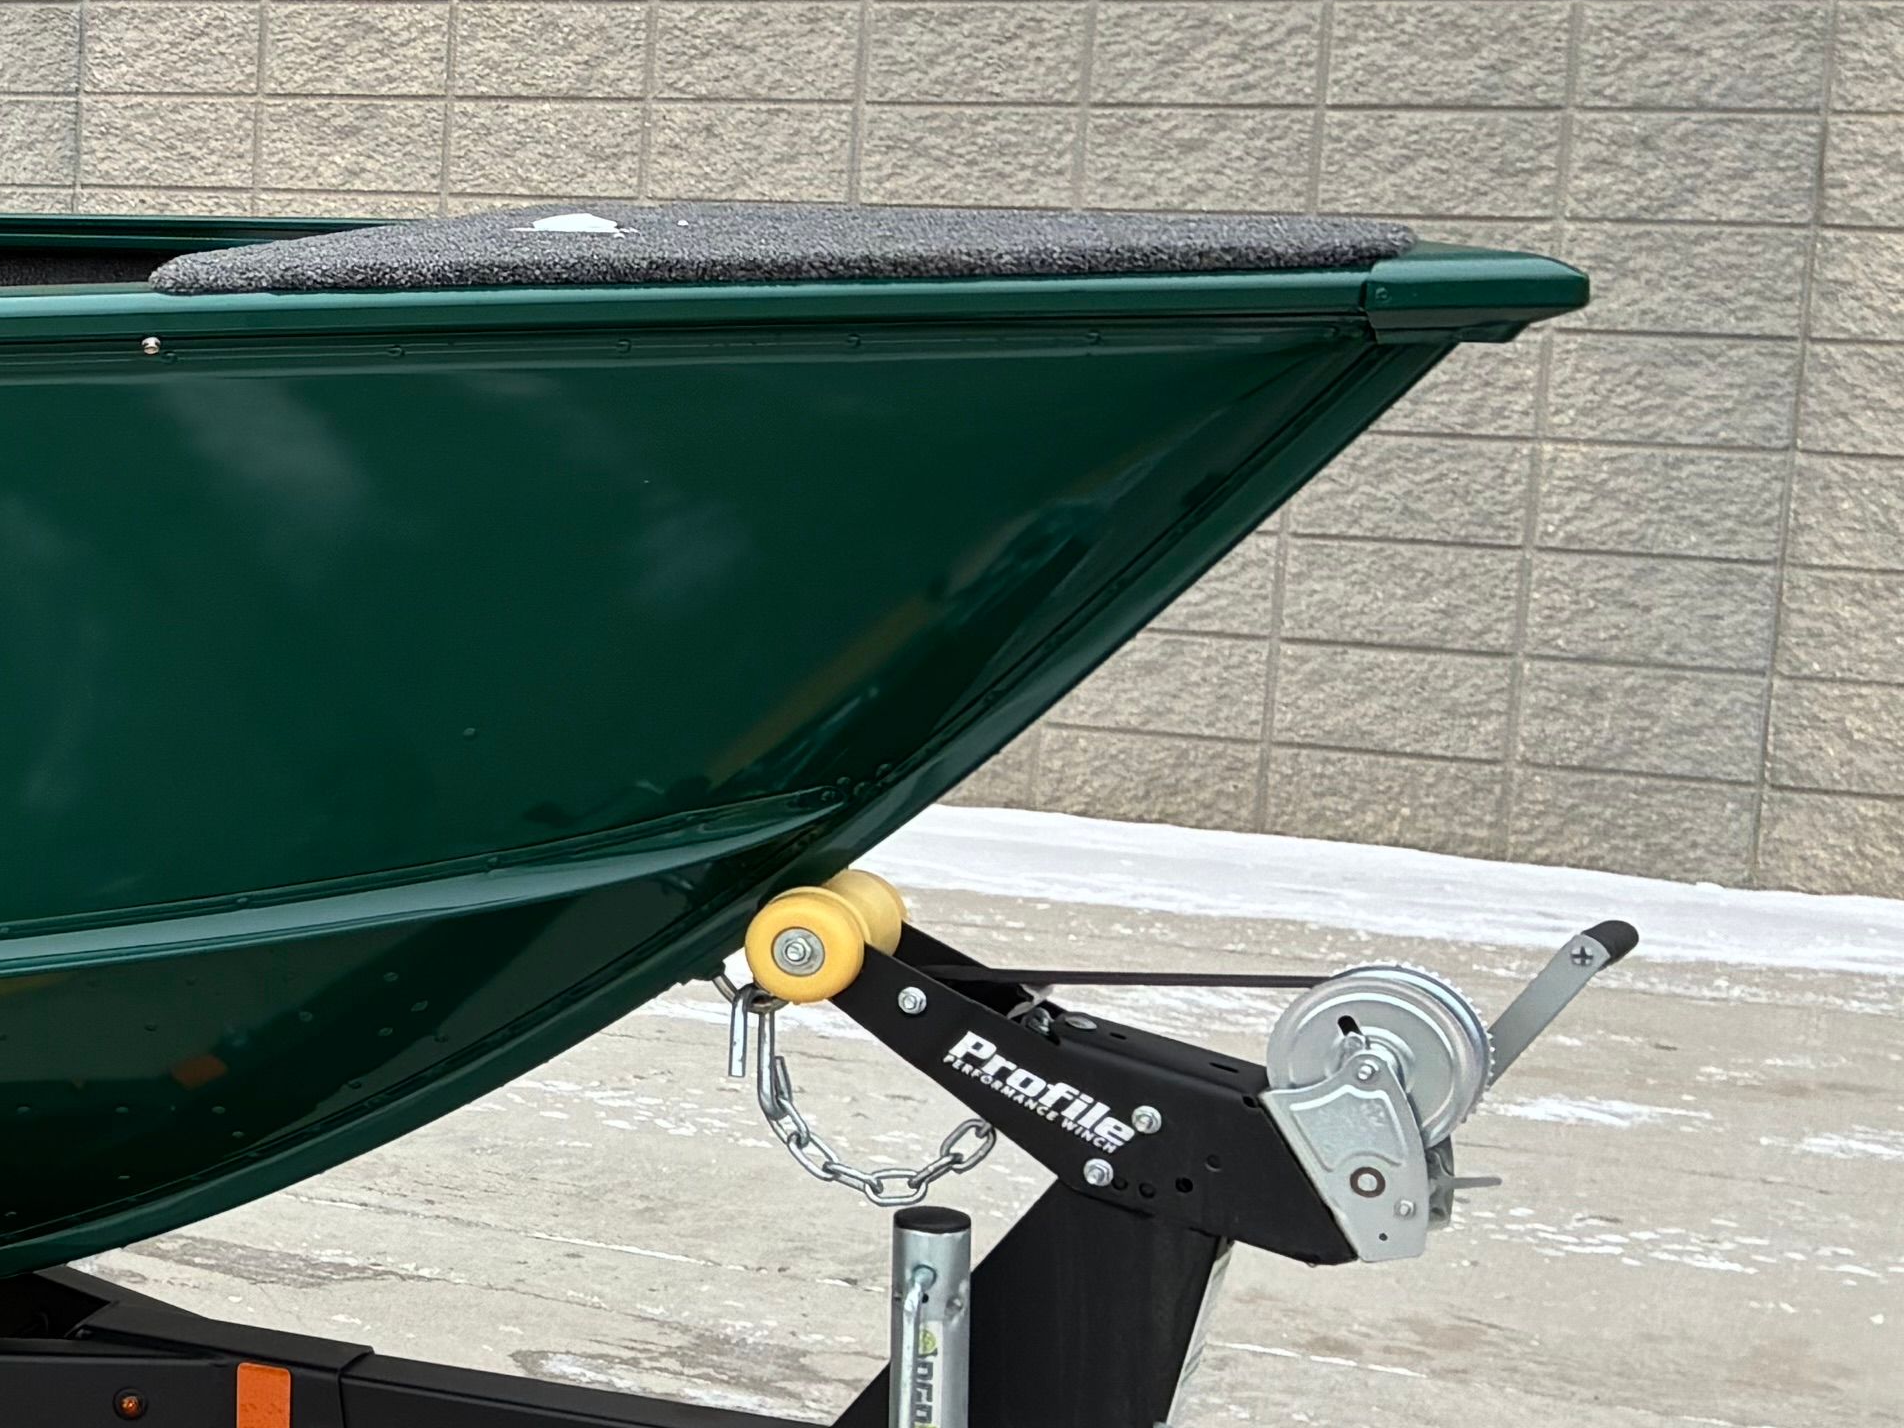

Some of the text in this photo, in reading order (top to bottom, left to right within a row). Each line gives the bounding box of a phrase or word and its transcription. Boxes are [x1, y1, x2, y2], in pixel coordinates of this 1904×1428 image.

[943, 1054, 1119, 1154] PERFORMANCE WINCH
[948, 1030, 1135, 1147] Profile
